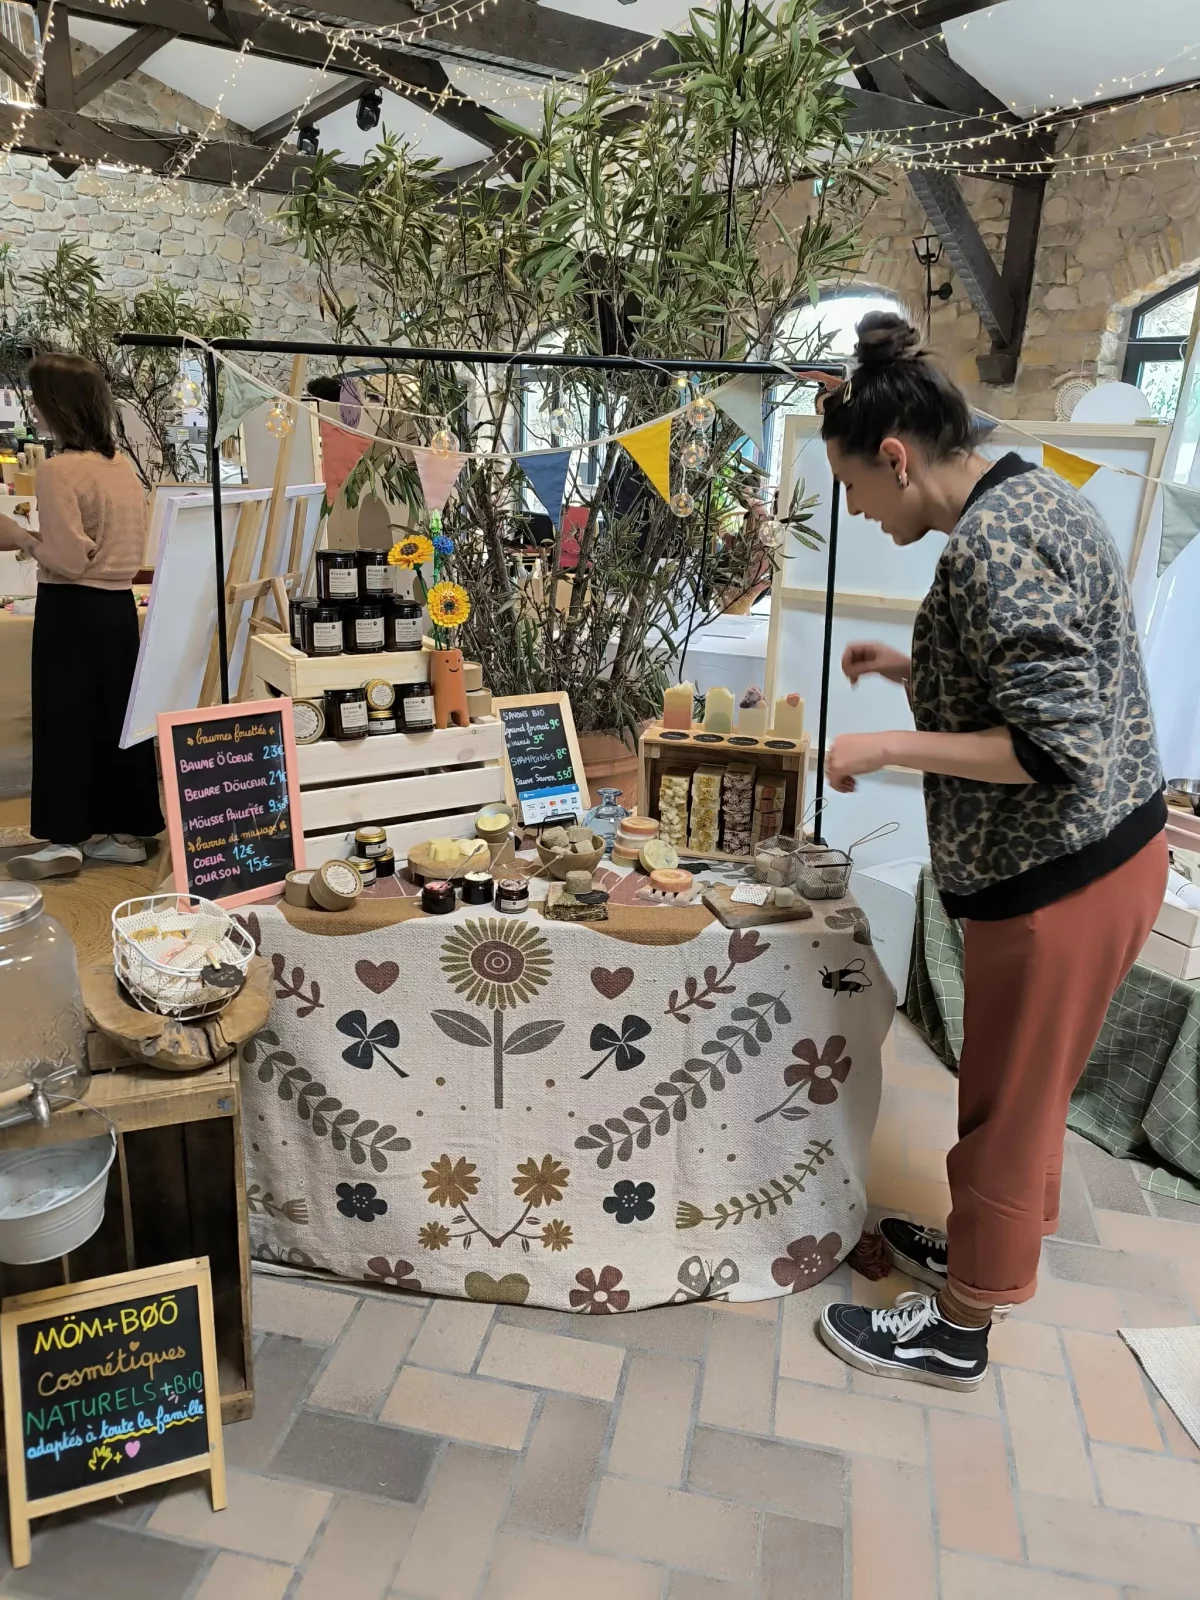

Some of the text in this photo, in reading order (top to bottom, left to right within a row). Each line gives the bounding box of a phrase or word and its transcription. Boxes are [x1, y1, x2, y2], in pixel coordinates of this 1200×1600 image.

[531, 709, 545, 719] BIO
[196, 723, 268, 745] baumes fouettés
[525, 721, 550, 737] format
[549, 718, 560, 730] 9€
[180, 758, 214, 774] BAUME
[263, 744, 285, 760] 23€
[511, 747, 567, 767] SHAMPOINGS 8€
[184, 770, 288, 801] BEURRE DÖUCEUR 21€
[188, 813, 225, 831] MÖUSSE
[195, 836, 226, 851] barres
[228, 831, 240, 843] de
[193, 843, 255, 869] COEUR 12€
[194, 856, 272, 886] OURSON 15€
[38, 1344, 187, 1397] Cosmétiques
[25, 1382, 157, 1435] NATURELS
[26, 1398, 205, 1462] adaptés à toute la famille
